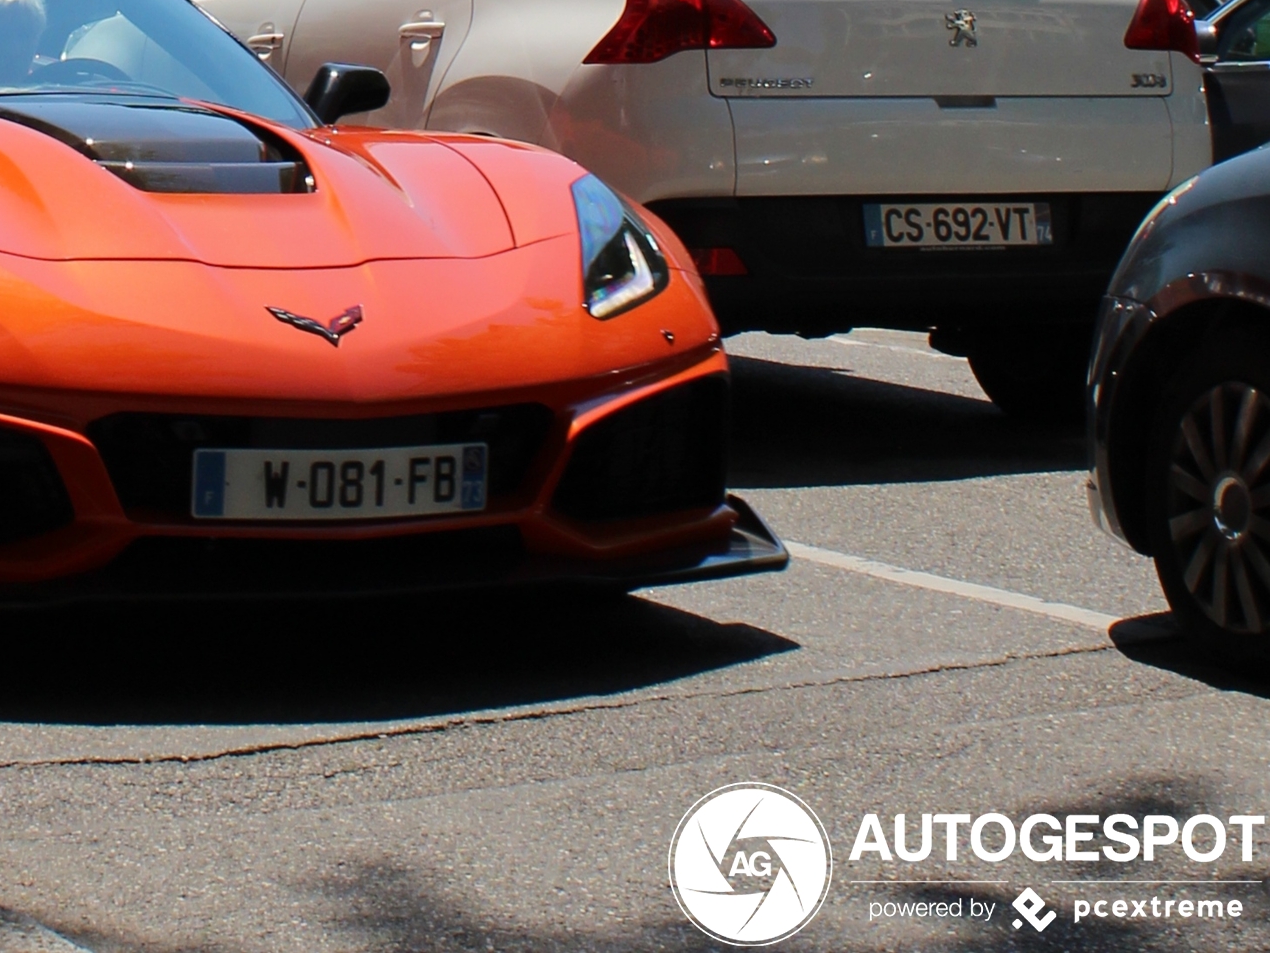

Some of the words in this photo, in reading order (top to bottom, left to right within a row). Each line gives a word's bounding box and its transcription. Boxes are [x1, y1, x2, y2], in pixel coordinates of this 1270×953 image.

[720, 78, 814, 89] PEUGEOT
[884, 207, 1030, 243] CS-692-VT
[1036, 225, 1052, 241] 74
[204, 490, 213, 504] F
[263, 455, 457, 509] W-081-FB
[462, 480, 483, 502] 73
